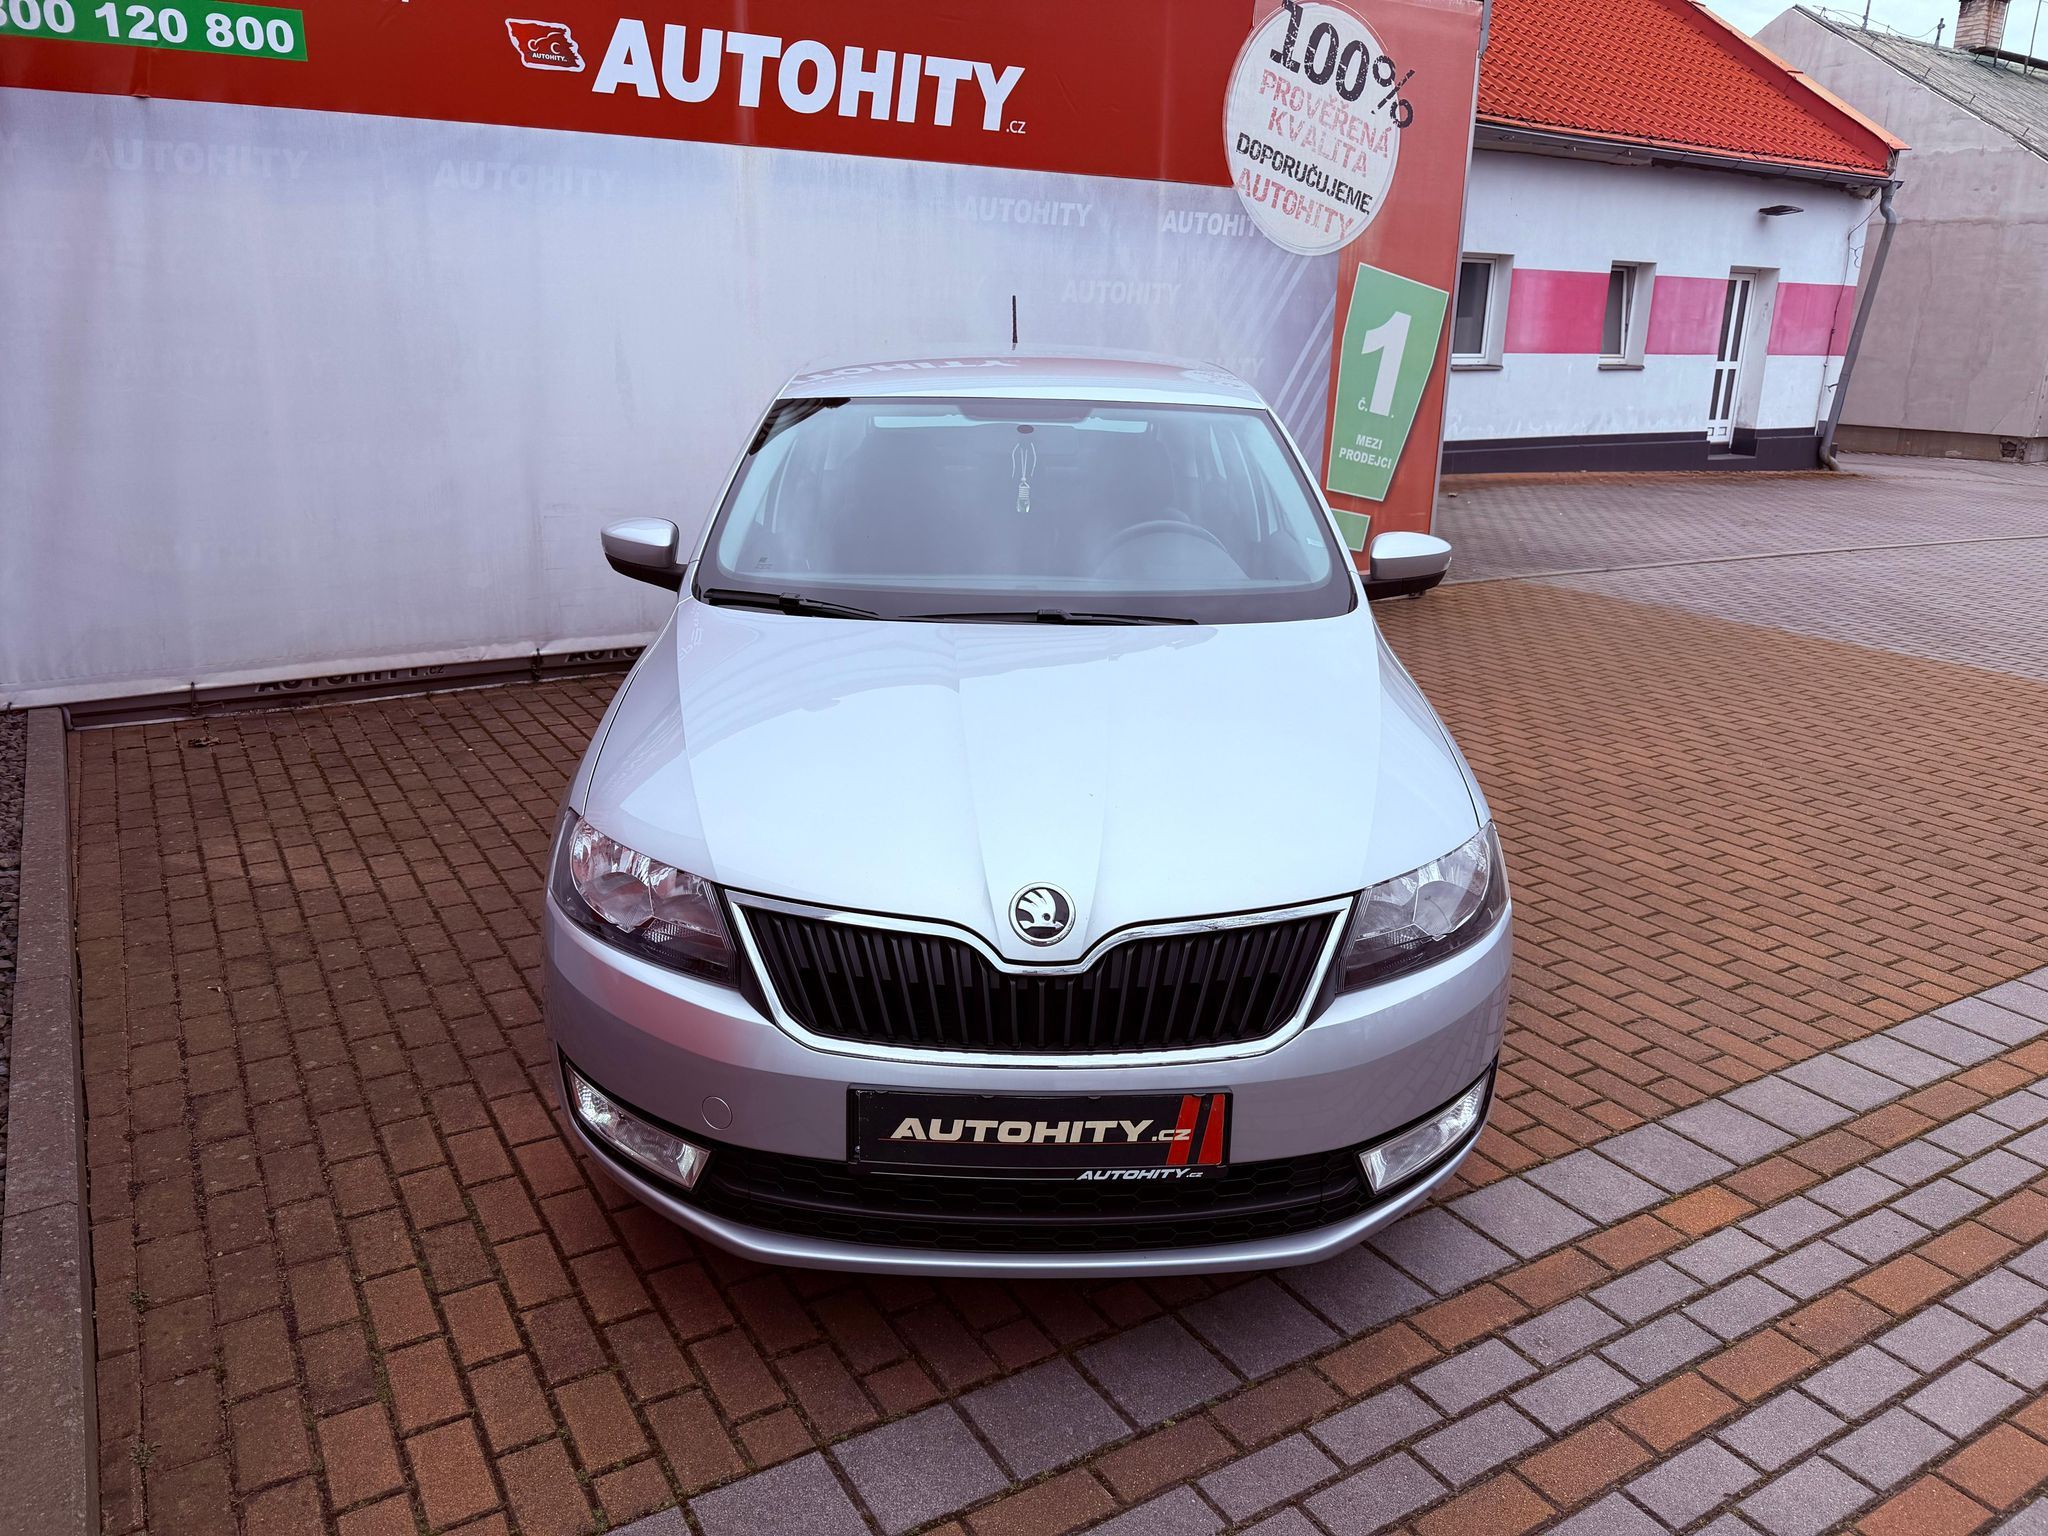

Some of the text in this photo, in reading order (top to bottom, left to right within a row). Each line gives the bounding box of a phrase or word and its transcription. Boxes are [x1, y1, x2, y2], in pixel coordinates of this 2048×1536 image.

[0, 0, 294, 53] 00 120 800
[1270, 0, 1415, 129] 100%
[1258, 69, 1392, 158] PROVĚŘENÁ
[82, 138, 311, 179] AUTOHITY
[1268, 107, 1368, 178] KVALITA
[433, 159, 622, 198] AUTOHITY
[1236, 132, 1373, 215] DOPORUČUJEME
[966, 196, 1093, 228] AUTOHITY
[1236, 168, 1354, 240] AUTOHITY
[1061, 280, 1182, 305] AUTOHITY
[1338, 446, 1393, 469] PRODEJCI
[1355, 433, 1383, 450] MEZI
